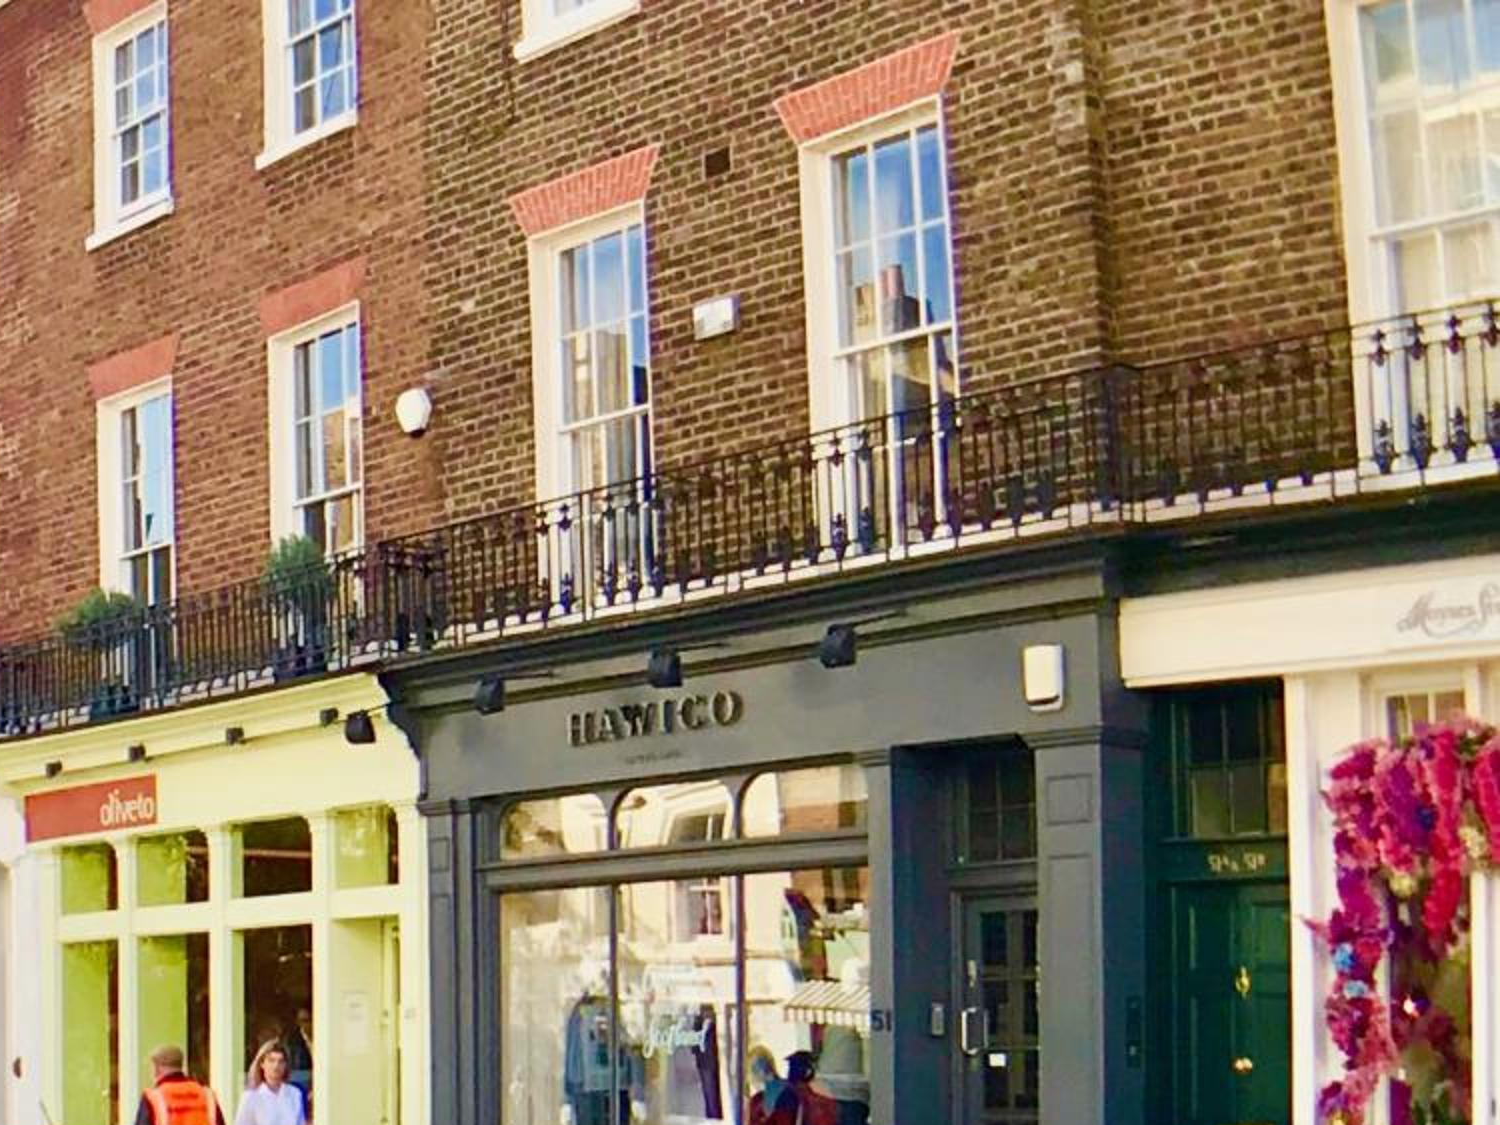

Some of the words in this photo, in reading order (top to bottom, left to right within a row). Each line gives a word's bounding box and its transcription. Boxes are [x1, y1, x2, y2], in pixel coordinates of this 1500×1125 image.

[566, 690, 744, 748] HAWICO
[99, 788, 155, 827] oliveto
[870, 1008, 892, 1033] 51
